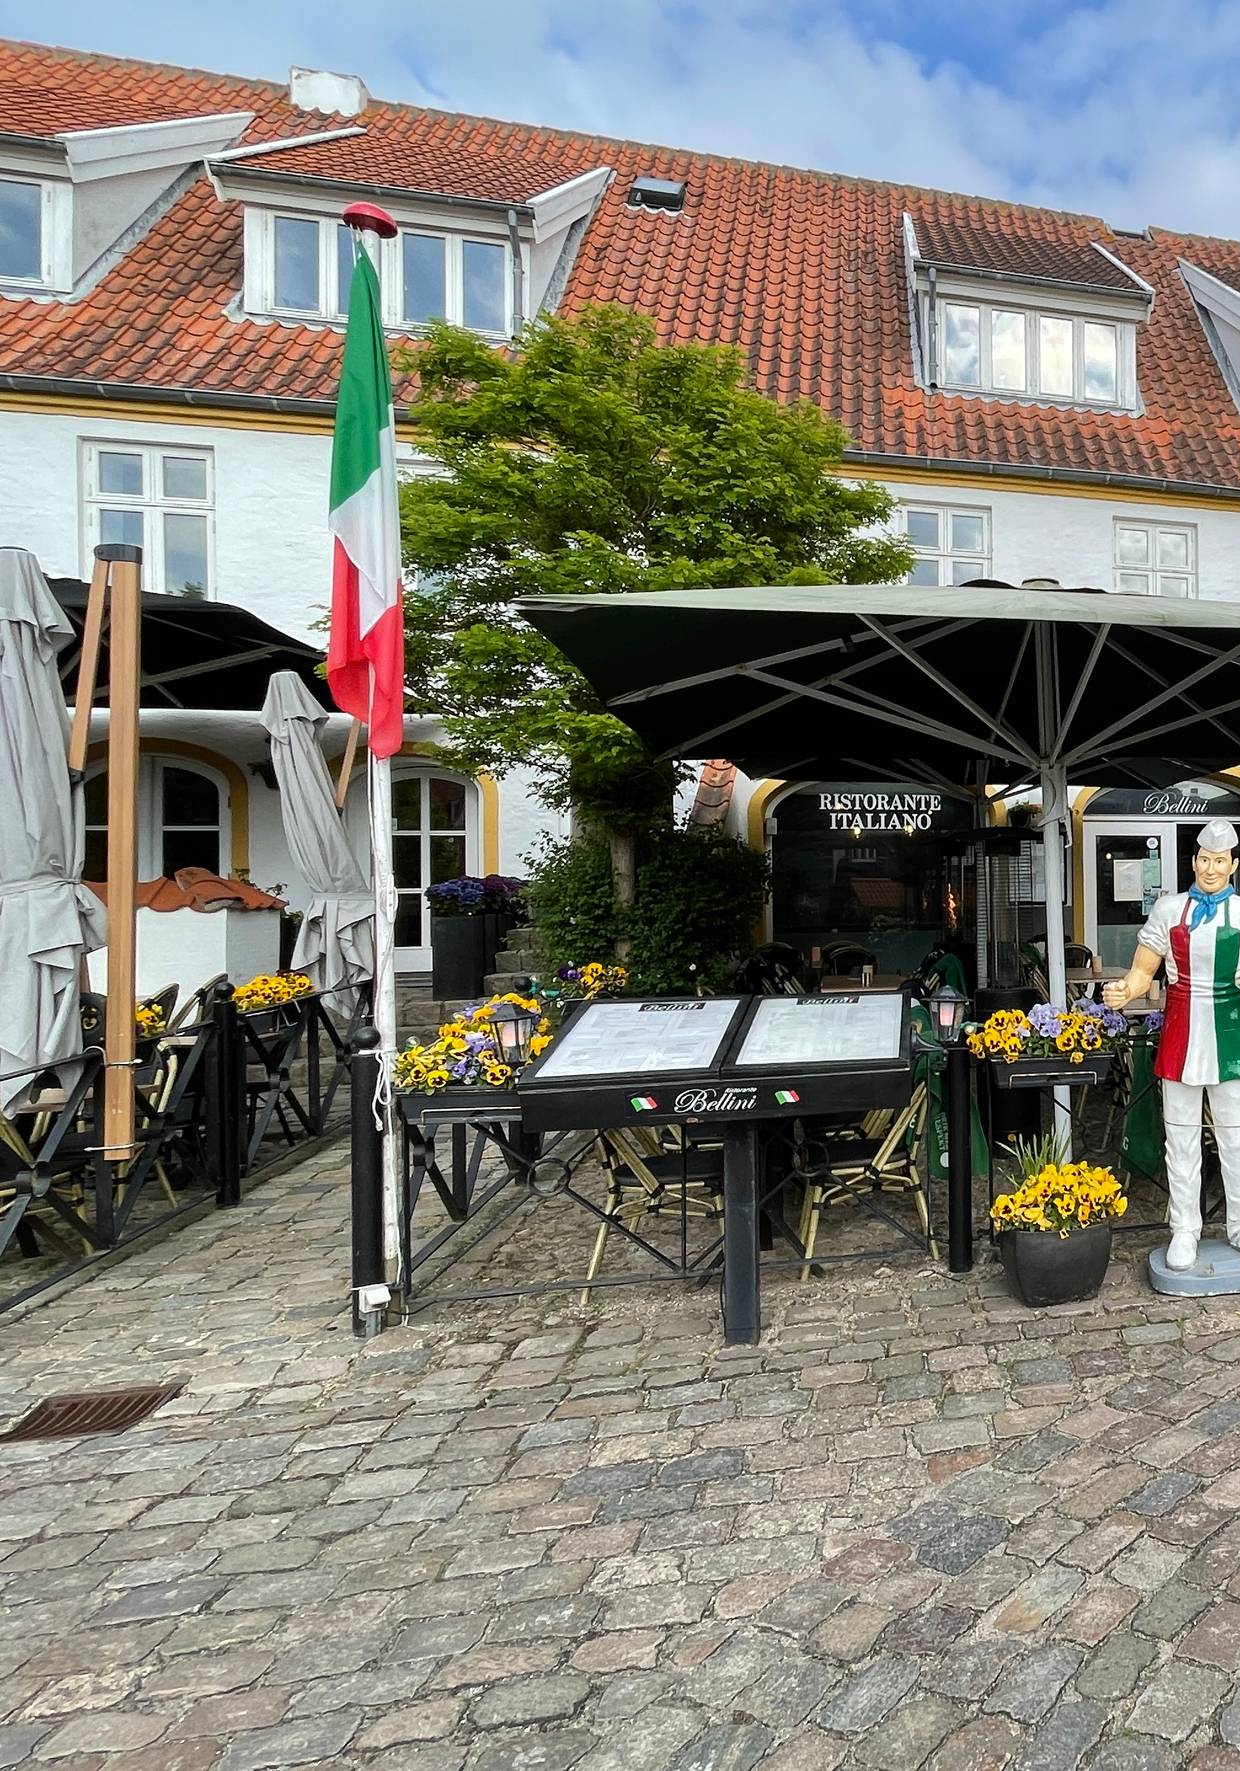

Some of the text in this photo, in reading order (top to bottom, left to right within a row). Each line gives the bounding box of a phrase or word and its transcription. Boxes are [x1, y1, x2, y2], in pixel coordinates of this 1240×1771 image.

[819, 793, 941, 811] RISTORANTE
[1143, 791, 1209, 814] Bellini
[829, 812, 932, 830] ITALIANO
[674, 1088, 757, 1113] Bellini
